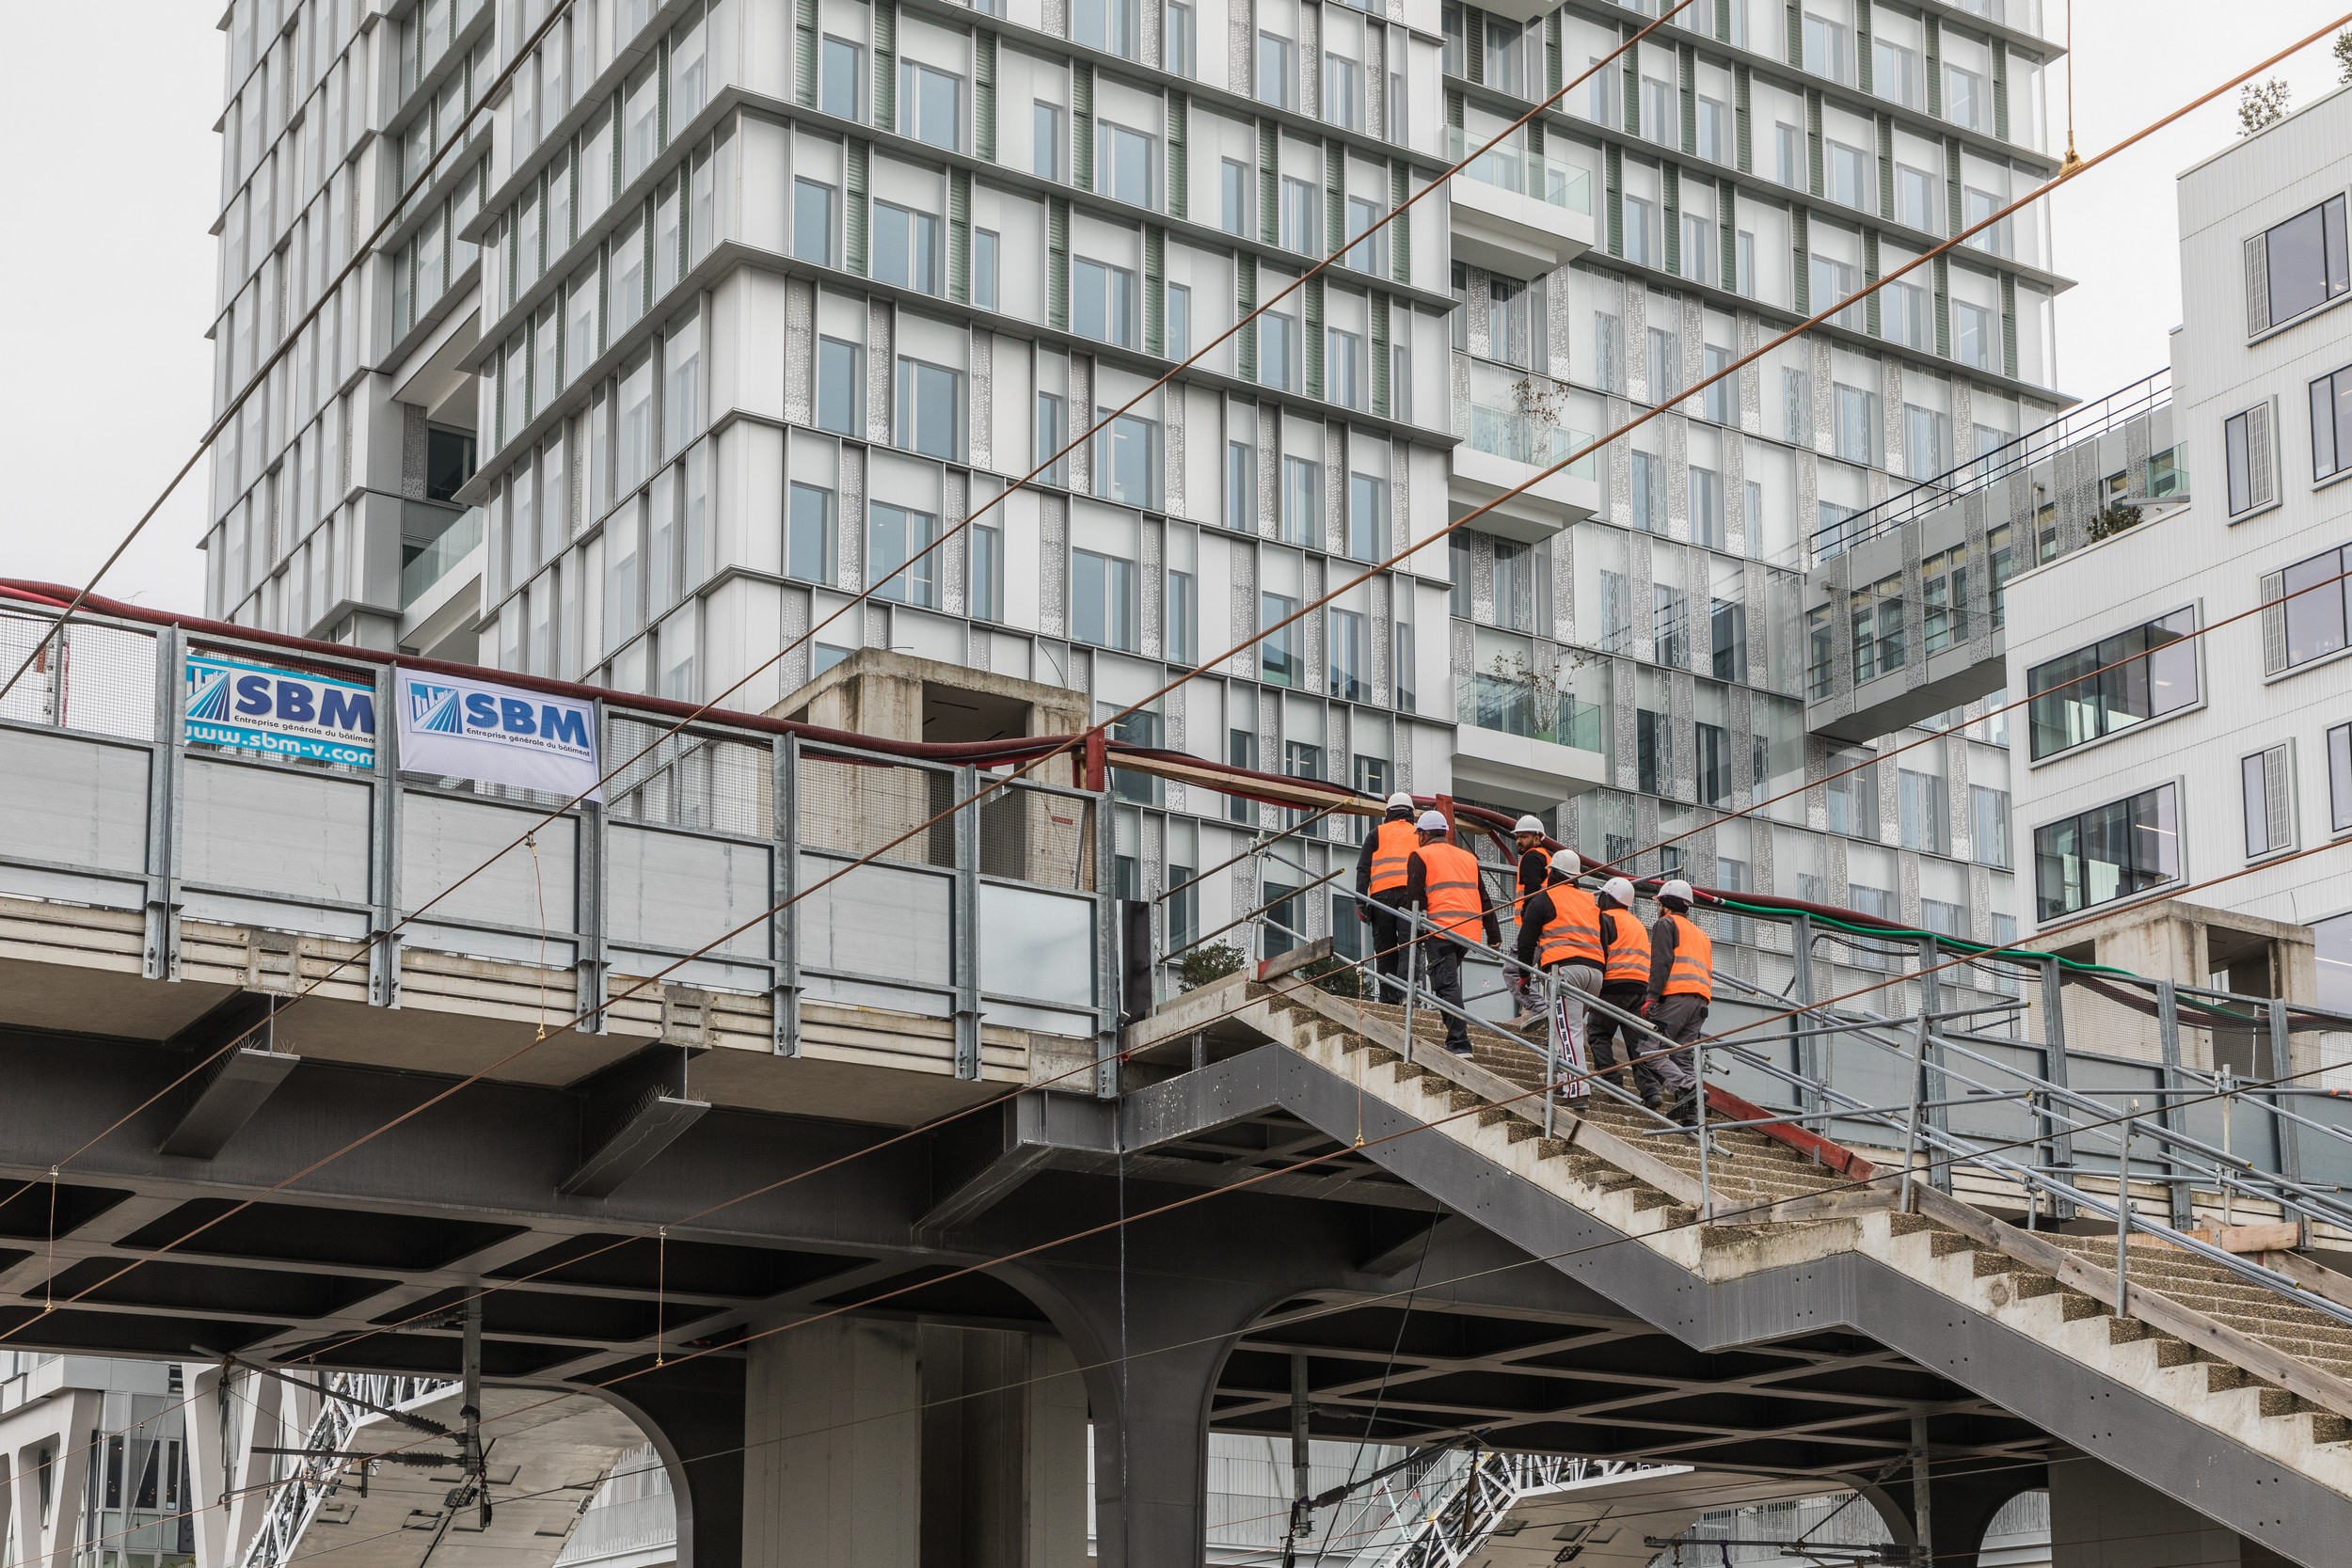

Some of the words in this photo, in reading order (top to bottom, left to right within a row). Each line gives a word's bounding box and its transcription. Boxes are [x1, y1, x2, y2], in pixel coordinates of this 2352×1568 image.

[235, 675, 374, 734] SBM
[466, 693, 589, 748] SBM
[234, 715, 279, 727] Entreprise
[282, 723, 322, 735] générale
[339, 731, 374, 743] bâtimen
[467, 727, 506, 740] Entreprise
[509, 735, 544, 746] générale
[547, 740, 556, 749] du
[558, 744, 590, 756] bâtiment
